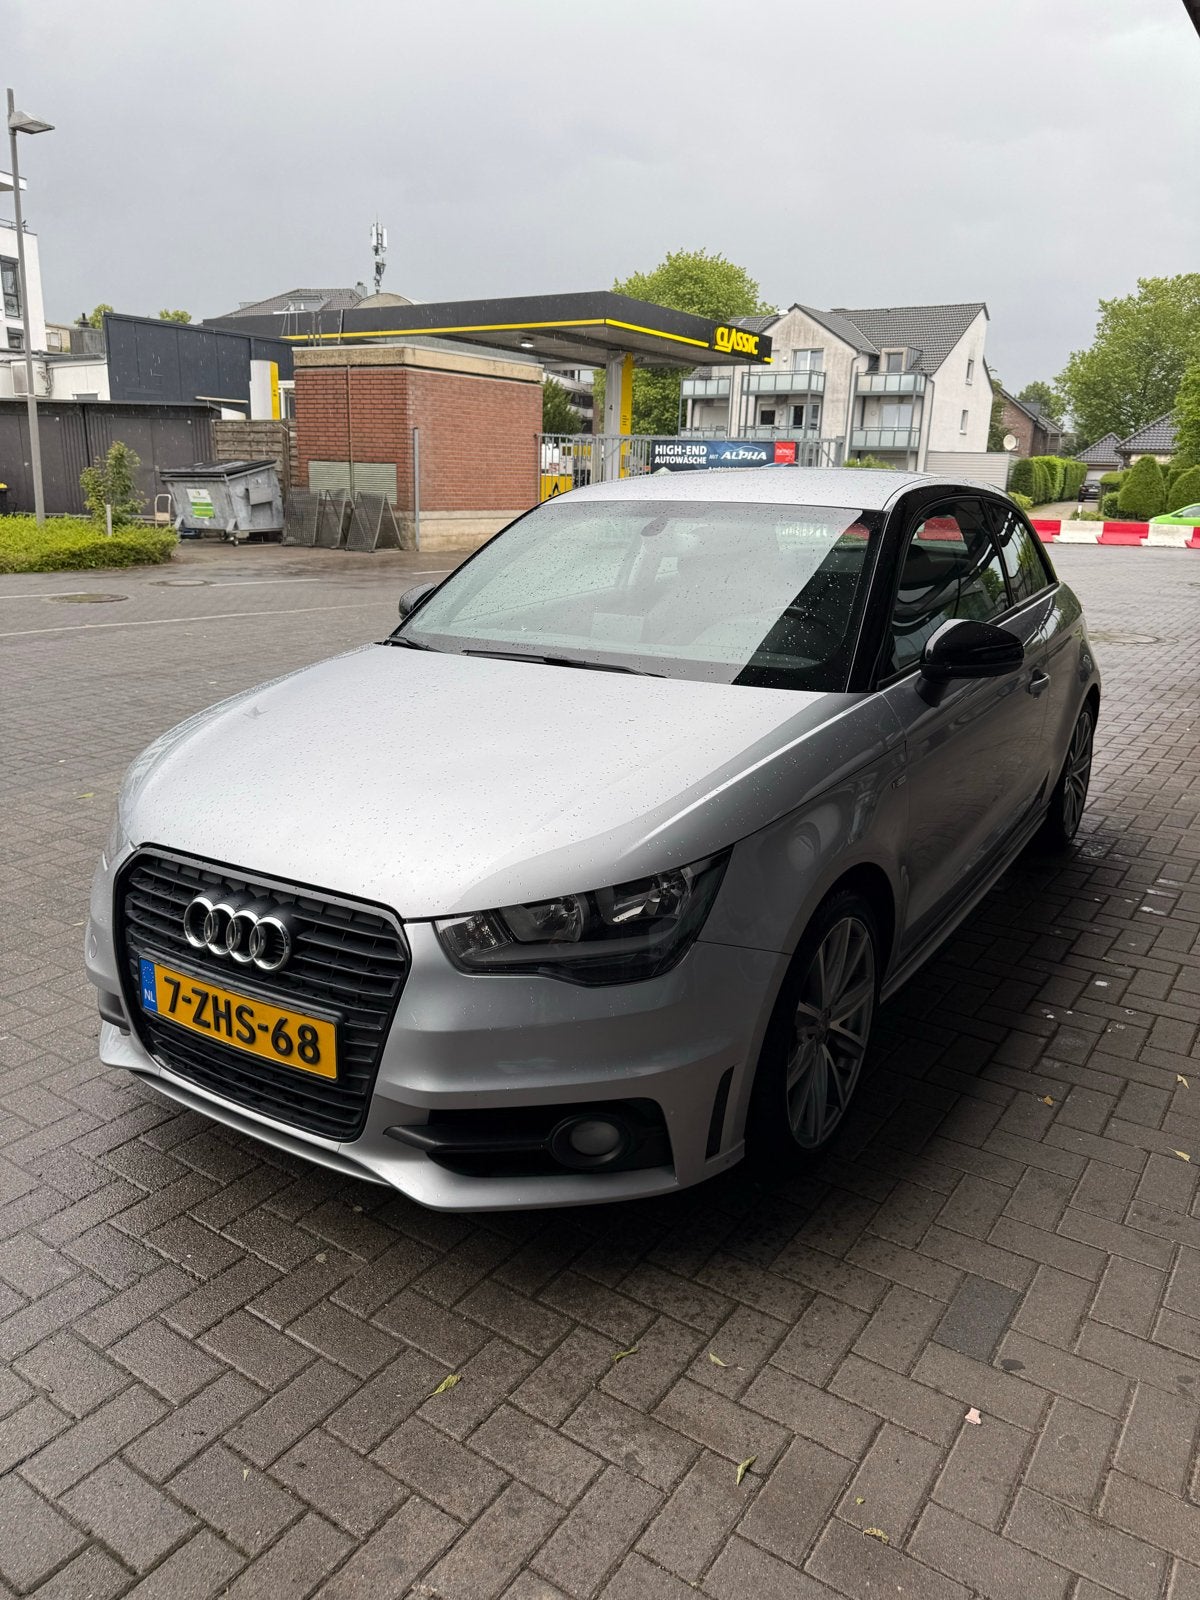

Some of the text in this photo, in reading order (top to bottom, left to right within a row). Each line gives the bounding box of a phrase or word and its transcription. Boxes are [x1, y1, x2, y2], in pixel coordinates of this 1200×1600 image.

[714, 326, 760, 355] CLASSIC
[655, 444, 708, 455] HIGH-END
[720, 450, 767, 460] ALPHA
[654, 455, 707, 464] AUTOWÄSCHE
[143, 988, 156, 1004] NL
[163, 976, 321, 1065] 7-ZHS-68
